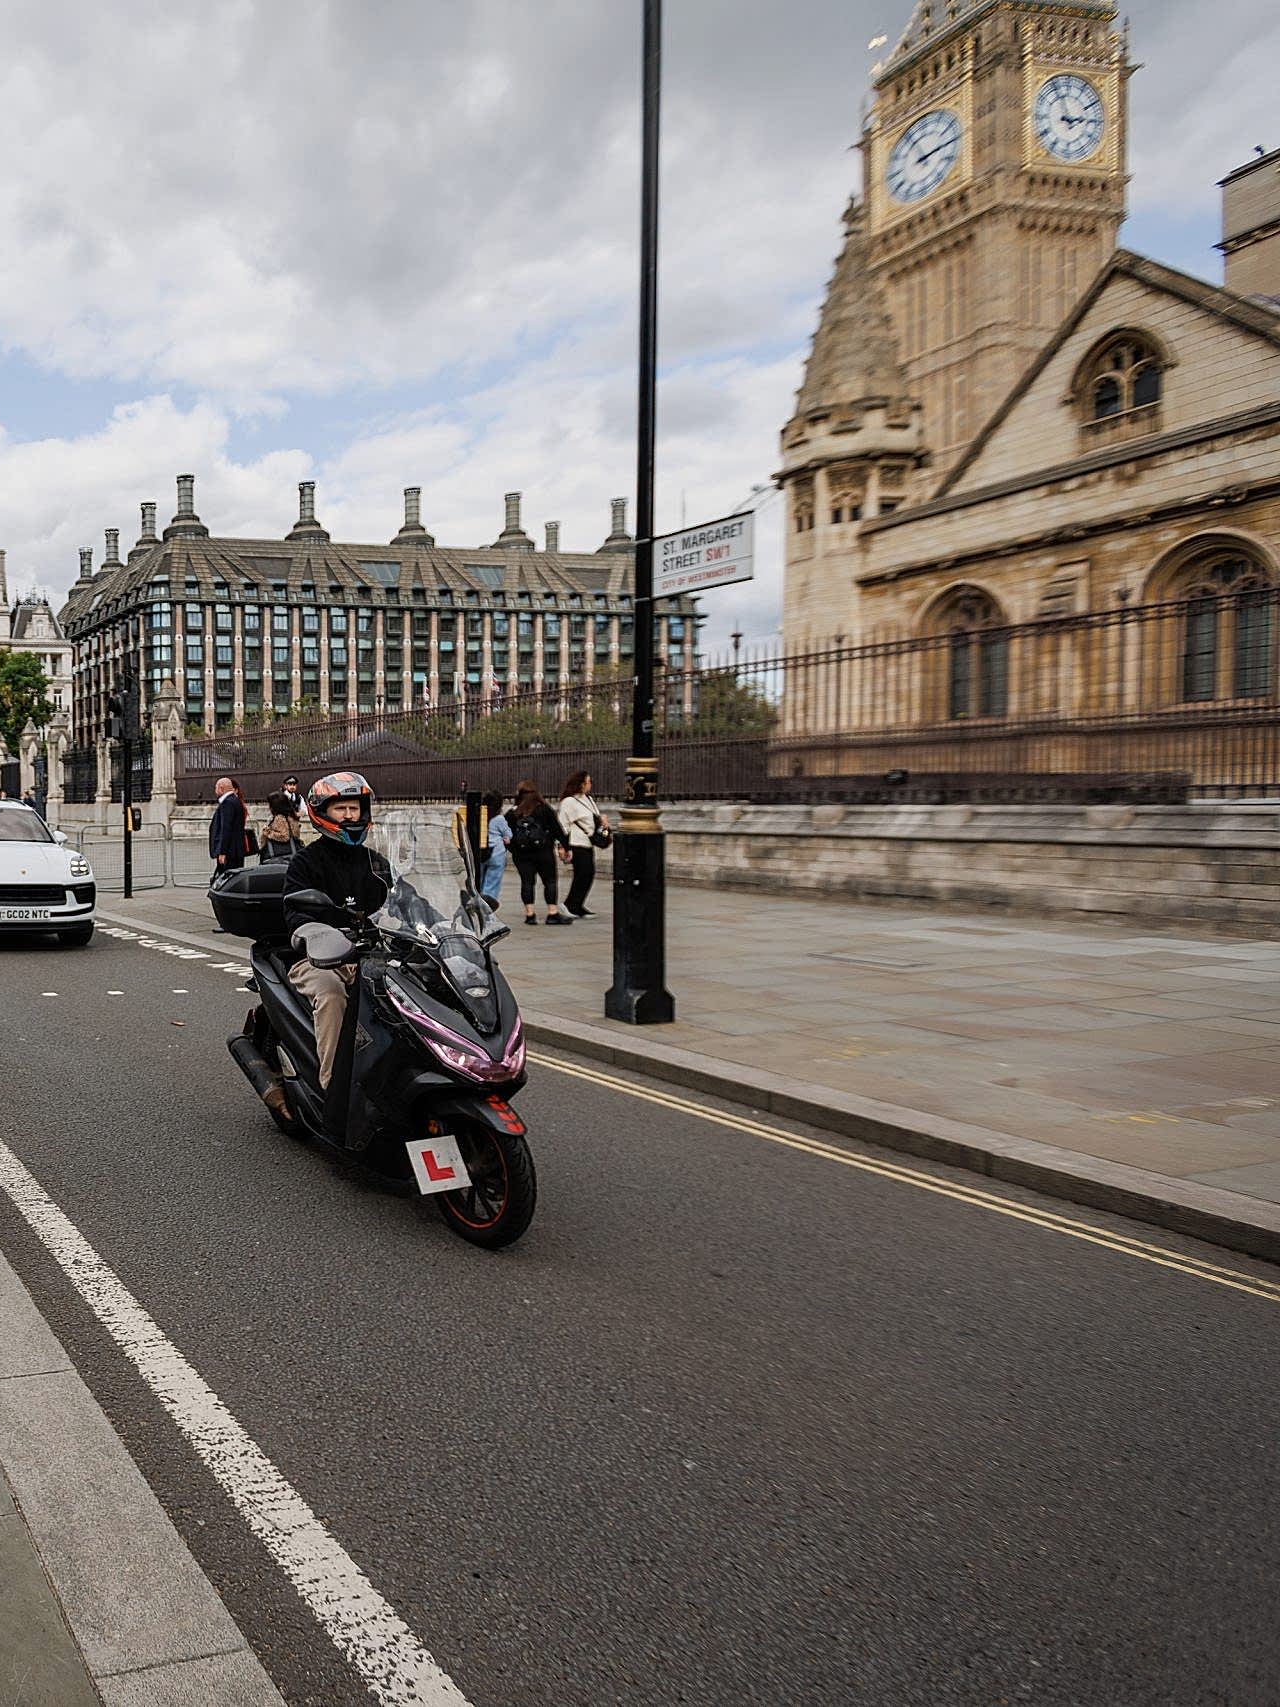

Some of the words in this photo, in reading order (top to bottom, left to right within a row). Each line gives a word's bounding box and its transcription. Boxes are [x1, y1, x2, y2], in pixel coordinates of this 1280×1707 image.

[682, 521, 744, 550] MARGARET
[663, 551, 702, 572] STREET
[706, 544, 730, 561] SW1
[6, 909, 30, 919] GC02
[32, 909, 49, 919] NTC
[420, 1150, 456, 1182] L
